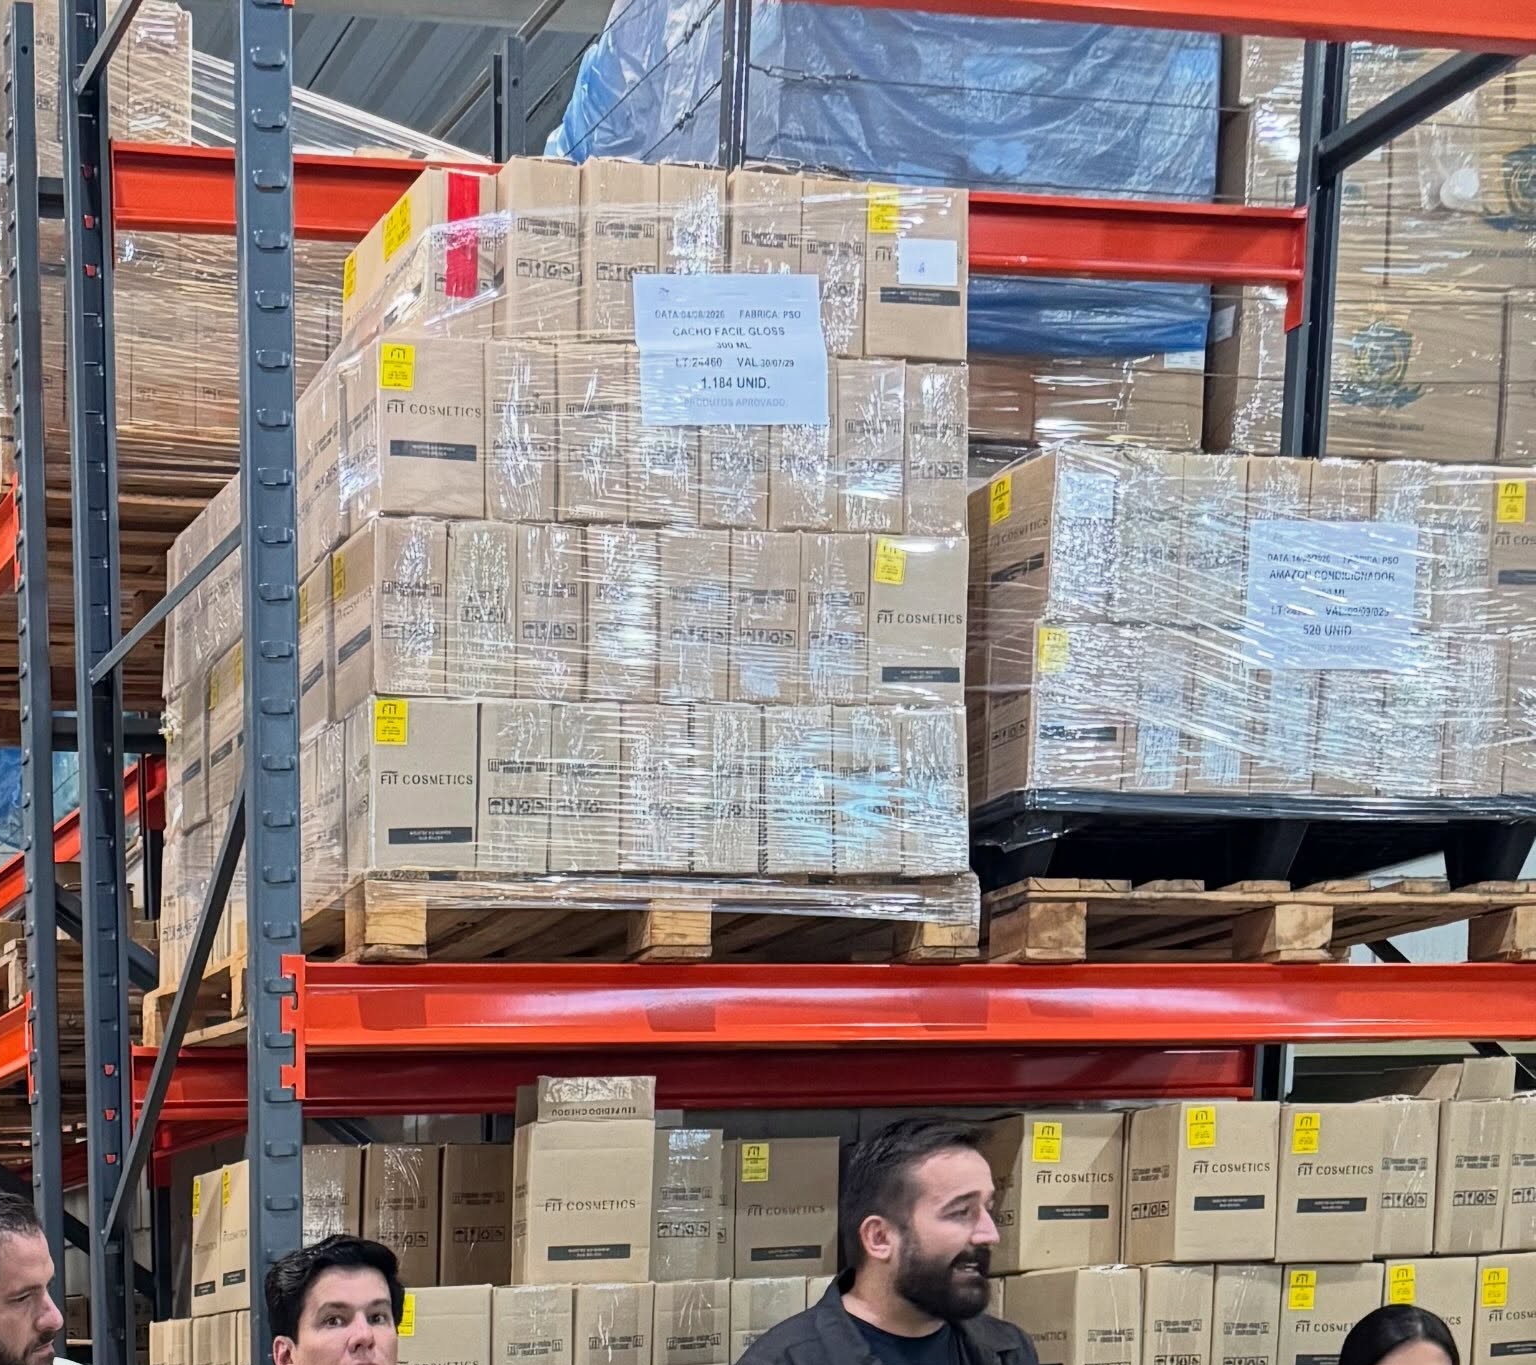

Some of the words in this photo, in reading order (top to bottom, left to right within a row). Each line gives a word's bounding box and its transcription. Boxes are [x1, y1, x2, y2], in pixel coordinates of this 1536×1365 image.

[673, 327, 711, 336] CACHO
[748, 327, 785, 336] GLOSS
[701, 377, 732, 389] 1.184
[386, 400, 405, 414] FIT
[409, 404, 482, 418] COSMETICS
[877, 611, 894, 624] FIT
[897, 613, 963, 624] COSMETICS
[380, 771, 399, 785] FIT
[403, 774, 473, 785] COSMETICS
[1193, 1161, 1210, 1174] FIT
[1212, 1163, 1270, 1173] COSMETICS
[1298, 1164, 1313, 1176] FIT
[1316, 1165, 1374, 1176] COSMETICS
[1036, 1171, 1052, 1184] FIT
[1055, 1173, 1114, 1184] COSMETICS
[545, 1199, 562, 1212] FIT
[566, 1200, 636, 1211] COSMETICS
[1489, 1311, 1504, 1322] FIT
[1295, 1321, 1311, 1333] FIT
